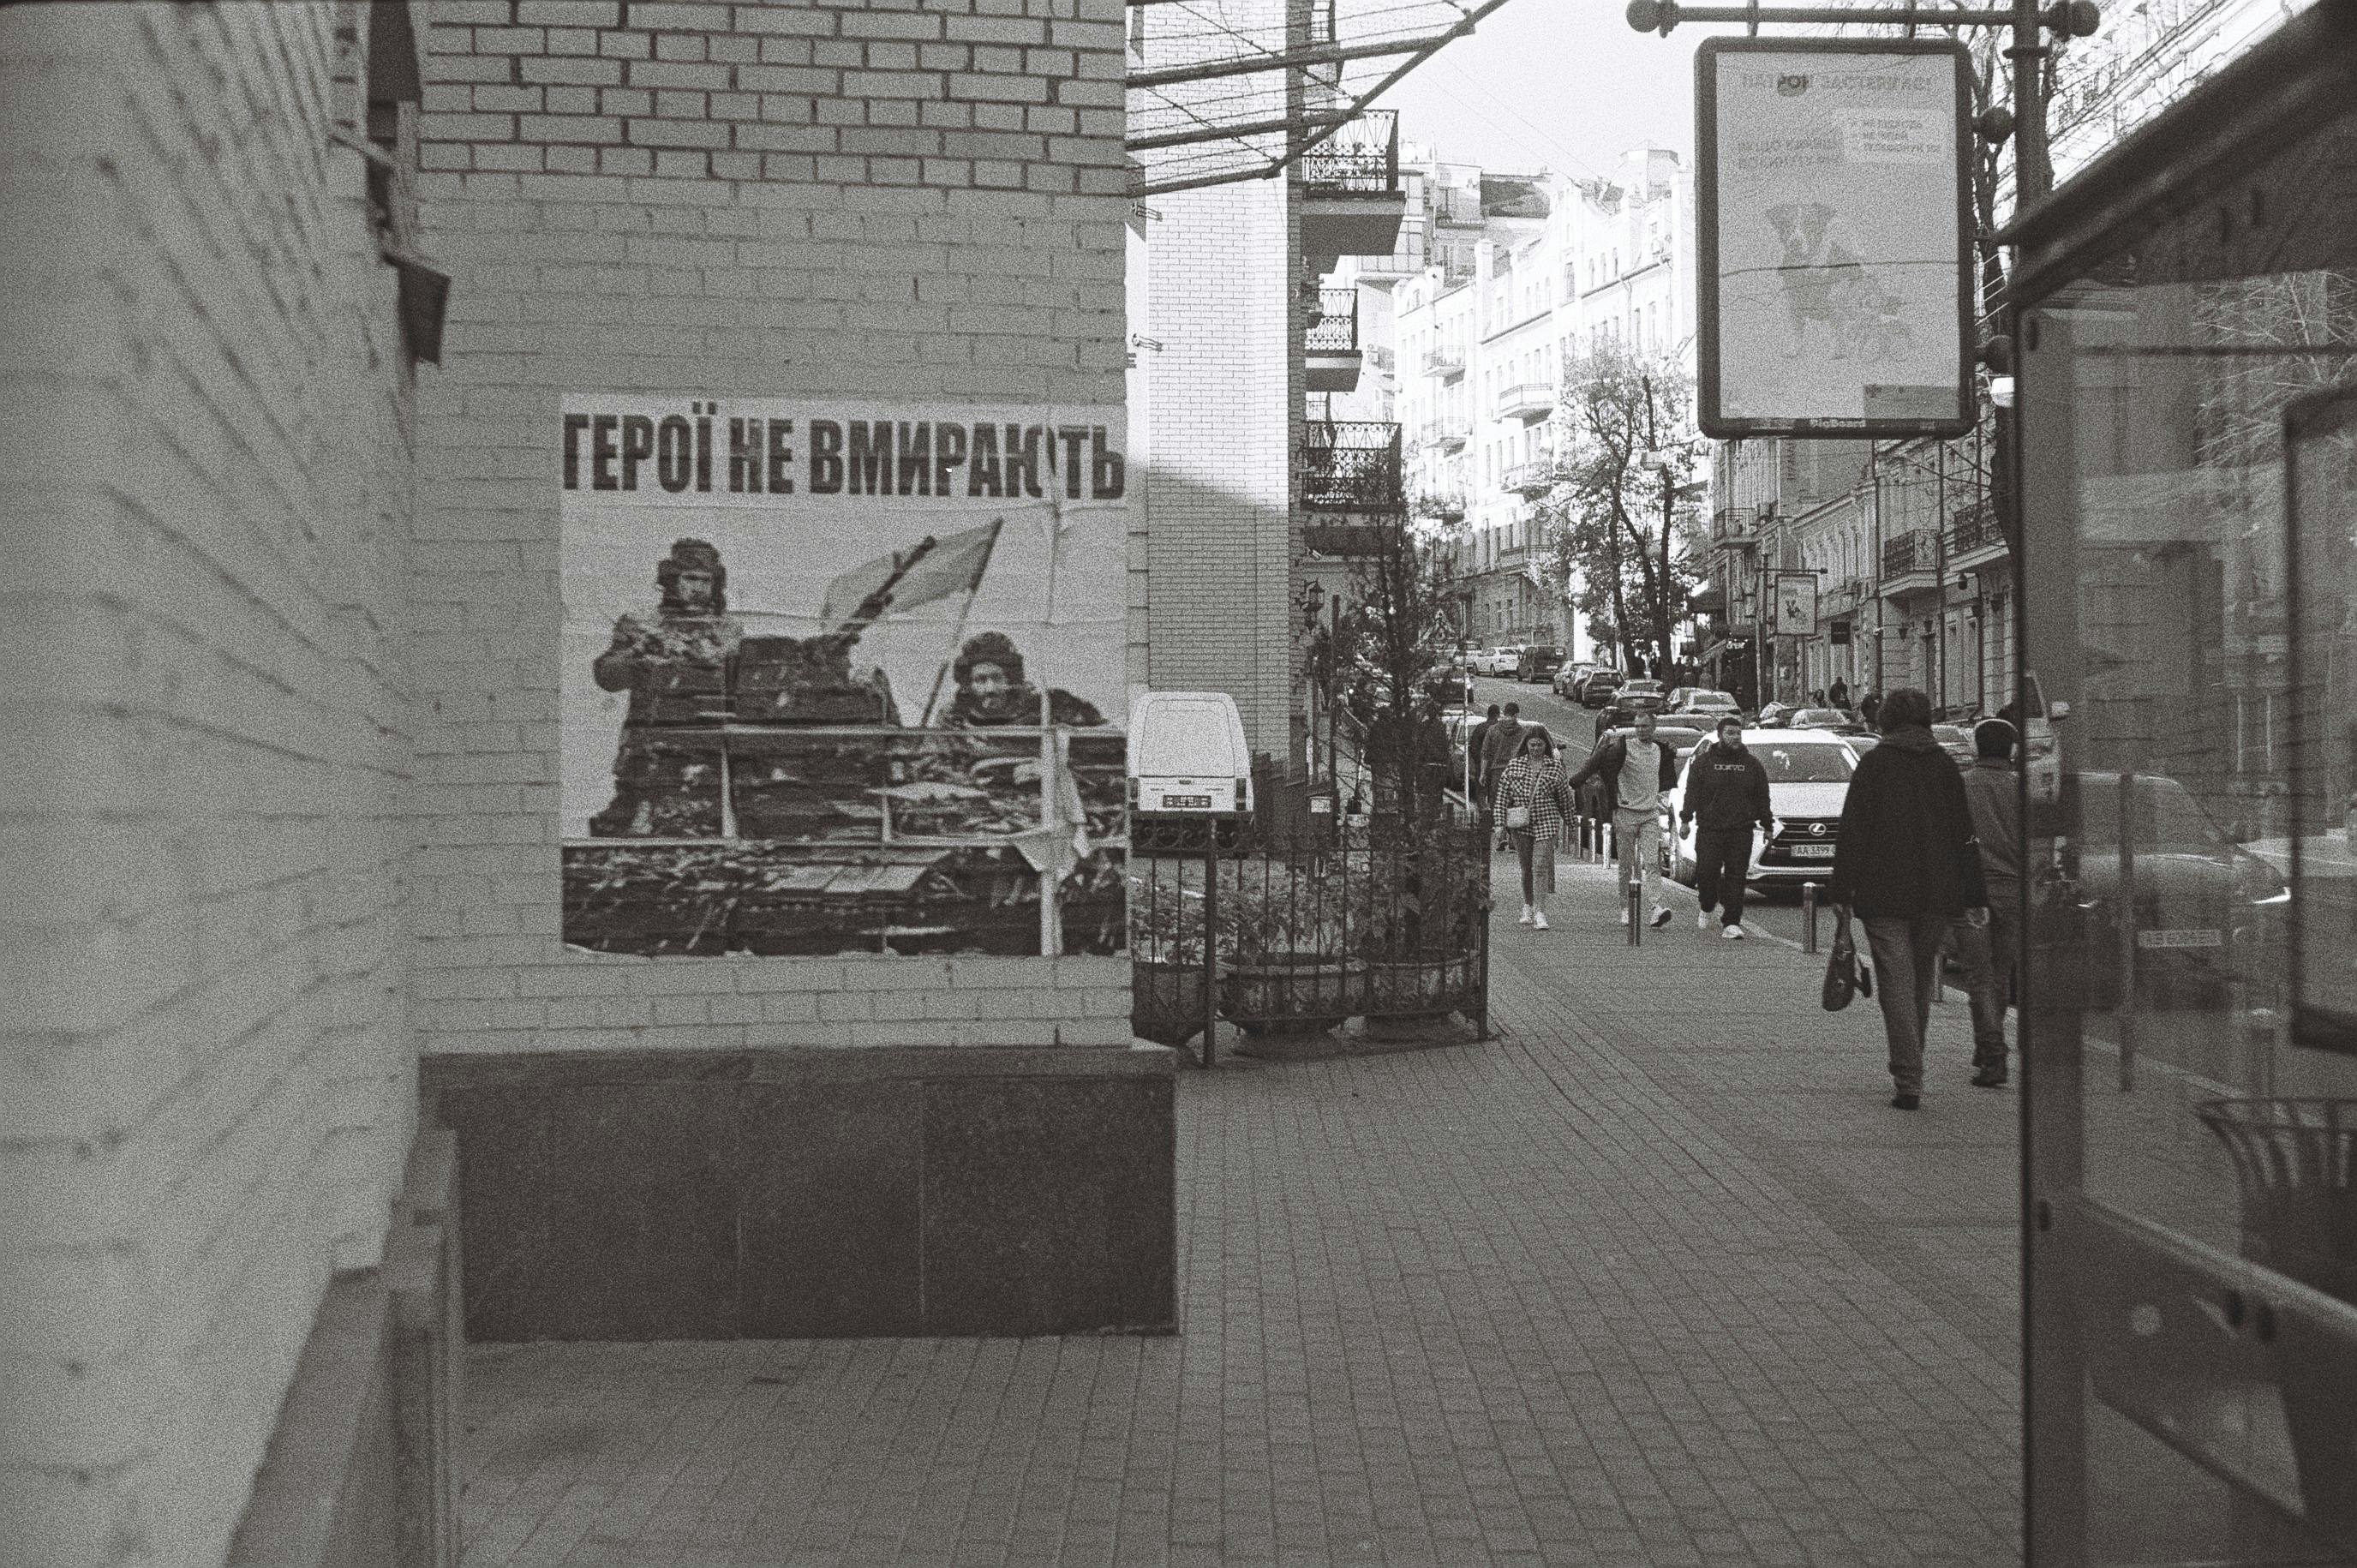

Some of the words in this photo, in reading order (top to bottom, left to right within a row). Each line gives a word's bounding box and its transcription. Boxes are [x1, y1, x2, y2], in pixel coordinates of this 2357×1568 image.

[564, 401, 717, 493] ГЕРОЇ
[729, 417, 793, 494] НЕ
[809, 418, 1125, 500] ВМИРАЮТЬ
